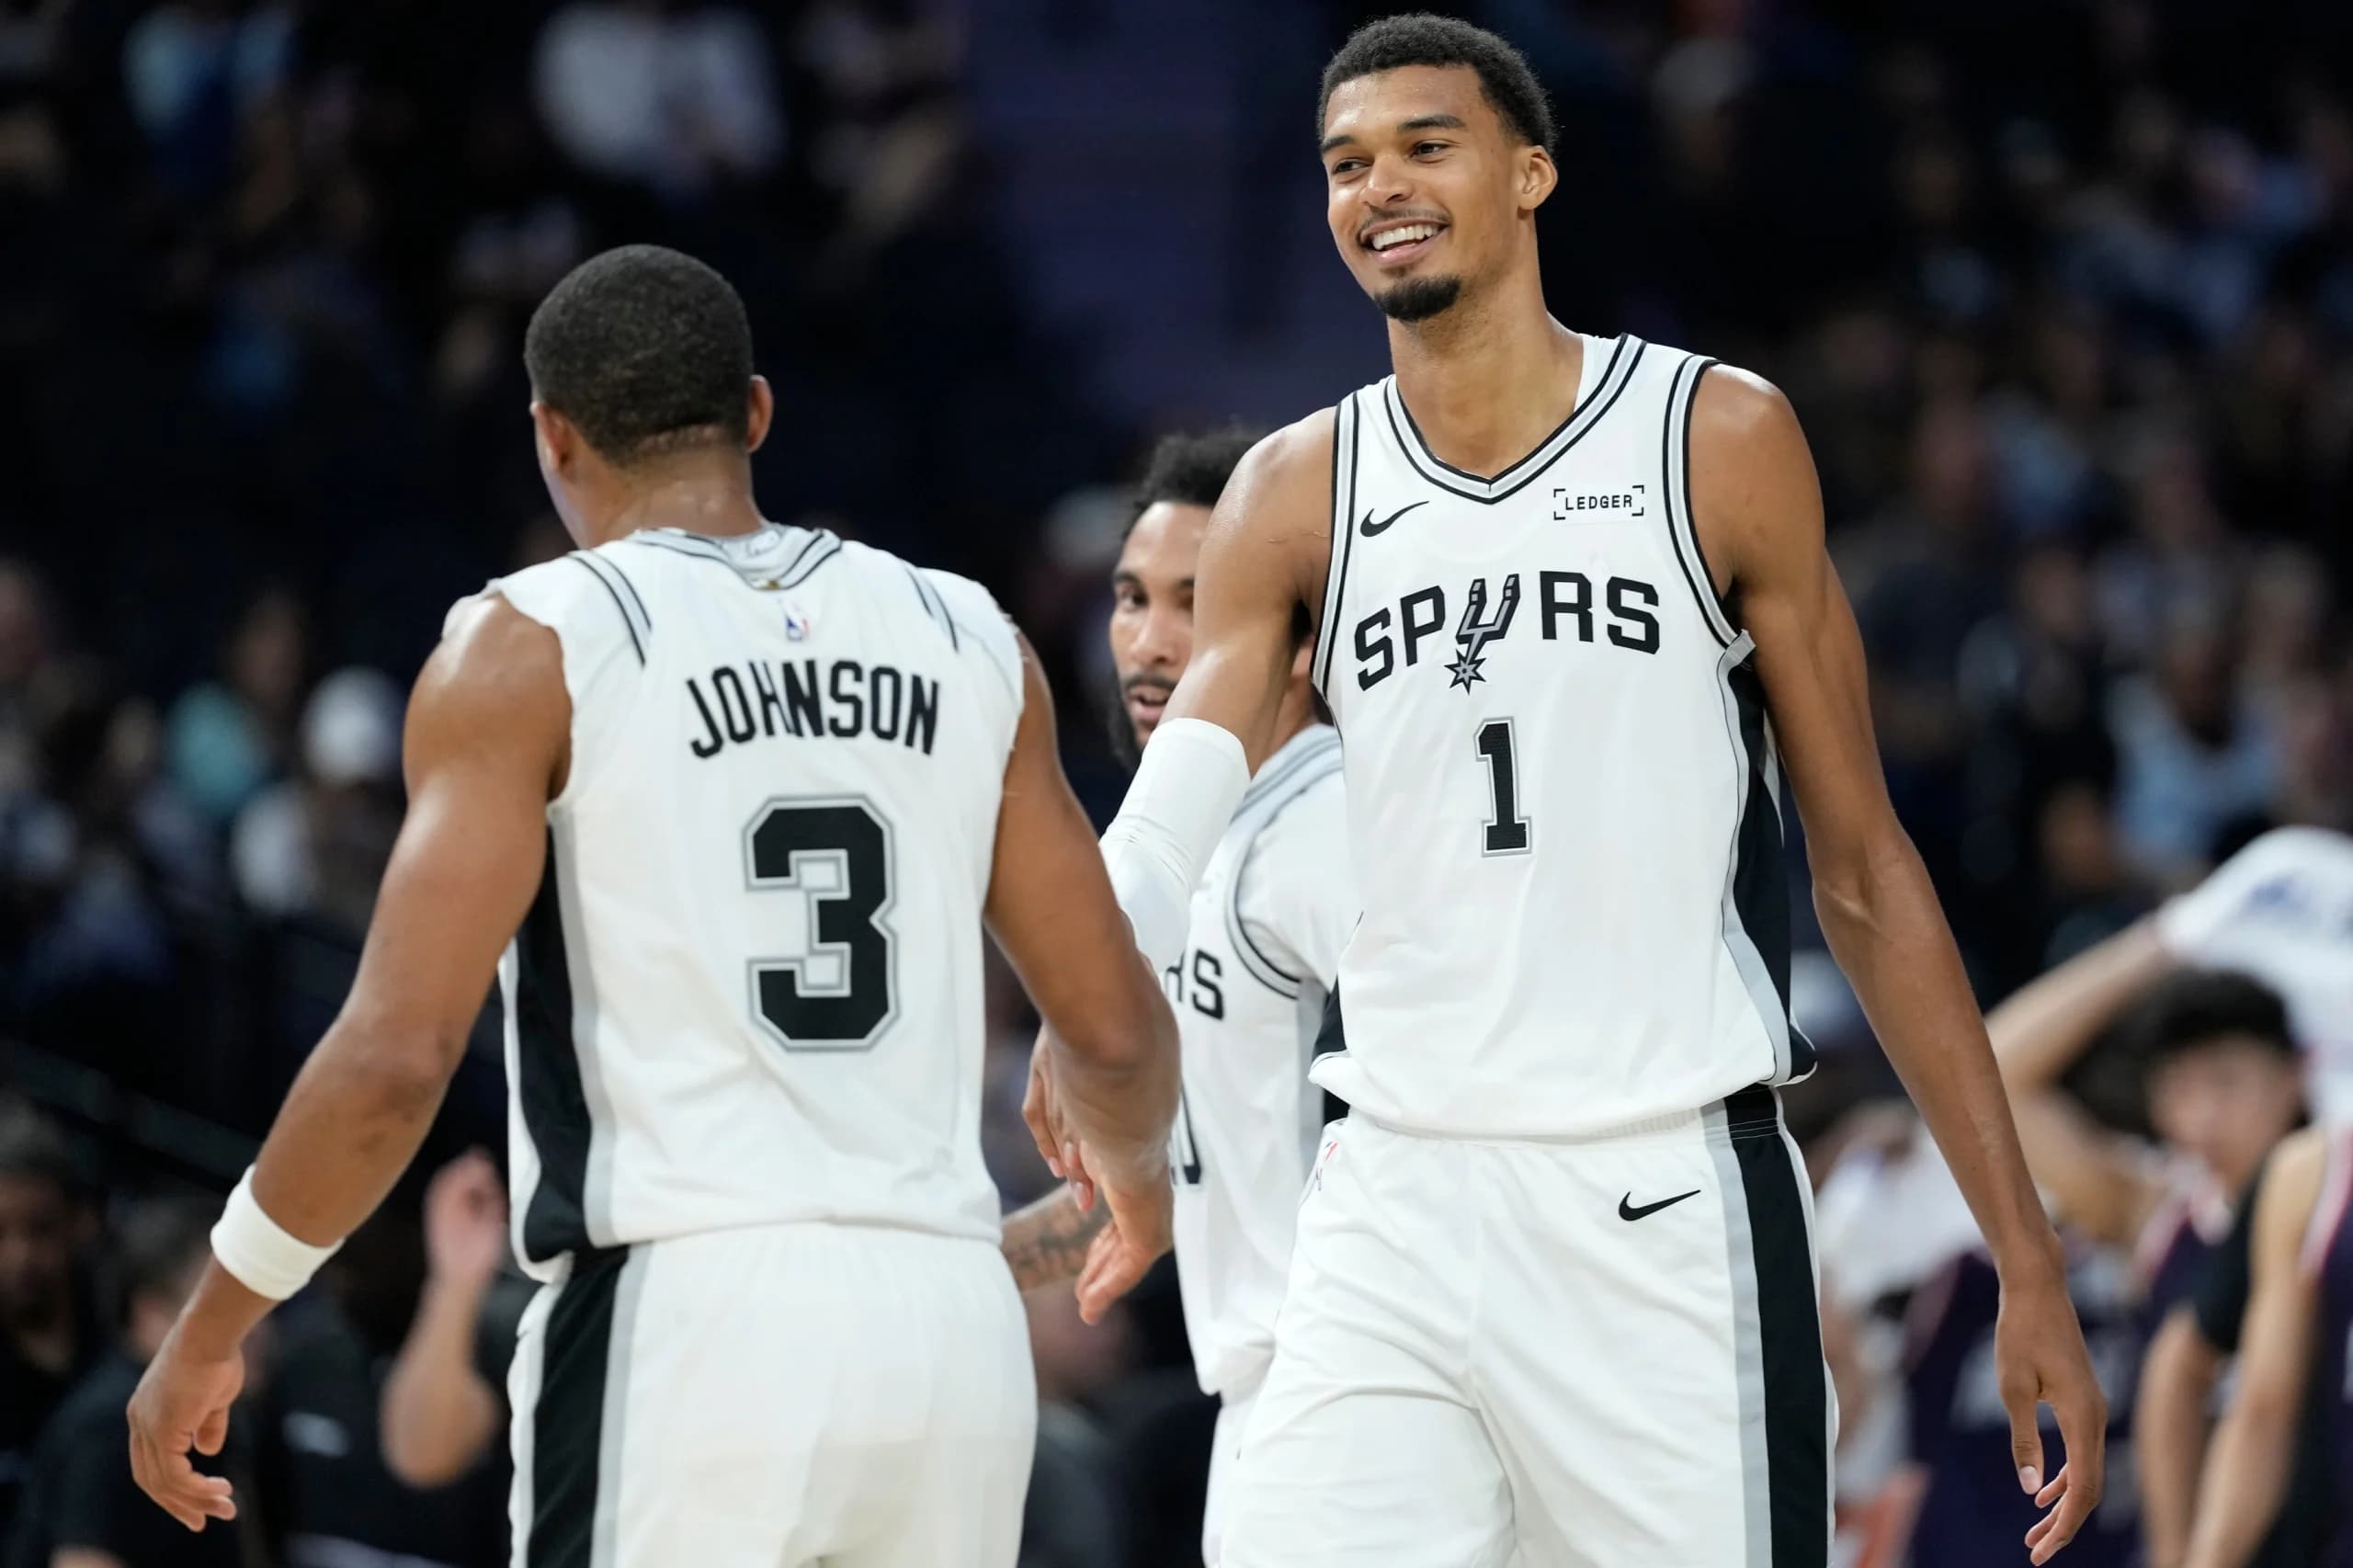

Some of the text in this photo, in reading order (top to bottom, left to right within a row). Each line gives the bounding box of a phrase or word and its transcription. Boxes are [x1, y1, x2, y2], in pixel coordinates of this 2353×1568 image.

[1564, 494, 1633, 511] LEDGER
[1354, 570, 1660, 695] SPURS
[686, 659, 939, 759] JOHNSON
[1473, 716, 1532, 858] 1
[741, 793, 902, 1053] 3
